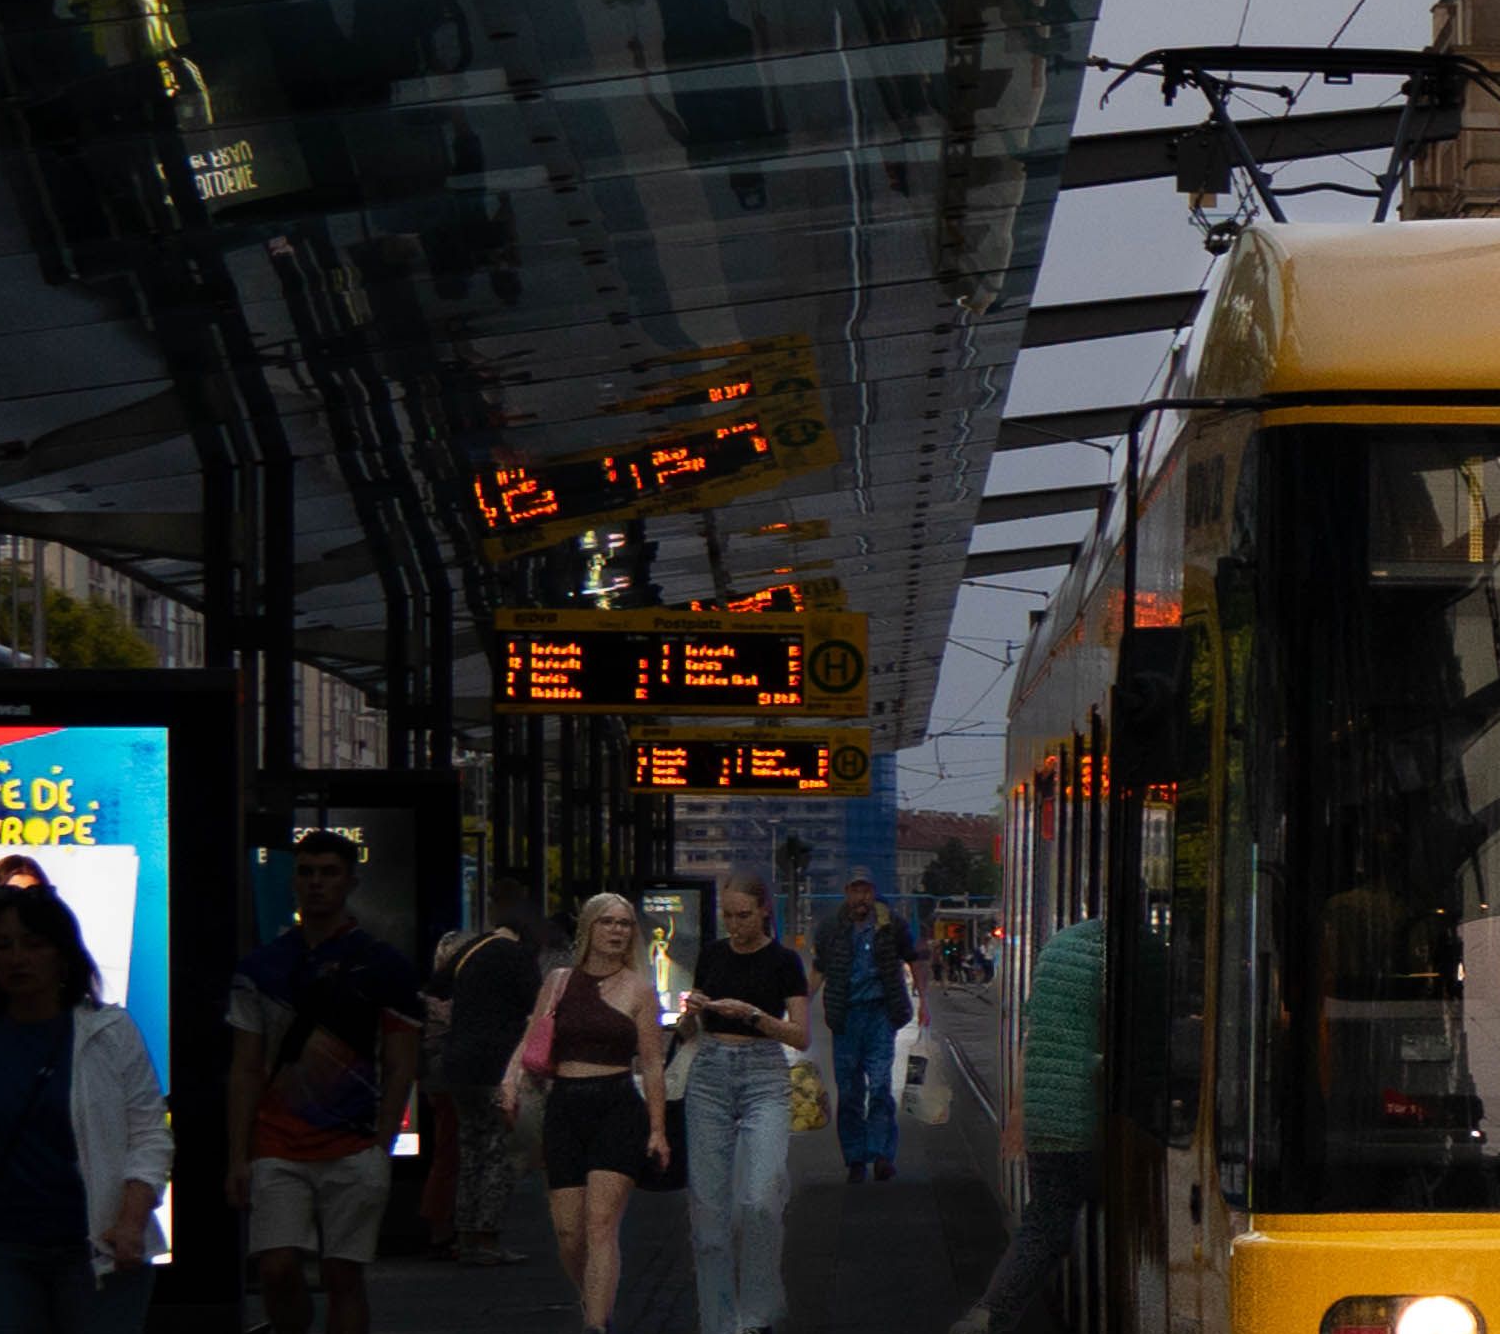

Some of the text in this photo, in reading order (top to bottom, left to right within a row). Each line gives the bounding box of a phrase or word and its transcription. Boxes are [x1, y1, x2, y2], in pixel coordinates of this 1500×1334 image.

[1461, 456, 1484, 562] 1
[826, 652, 847, 674] H
[30, 778, 76, 812] DE
